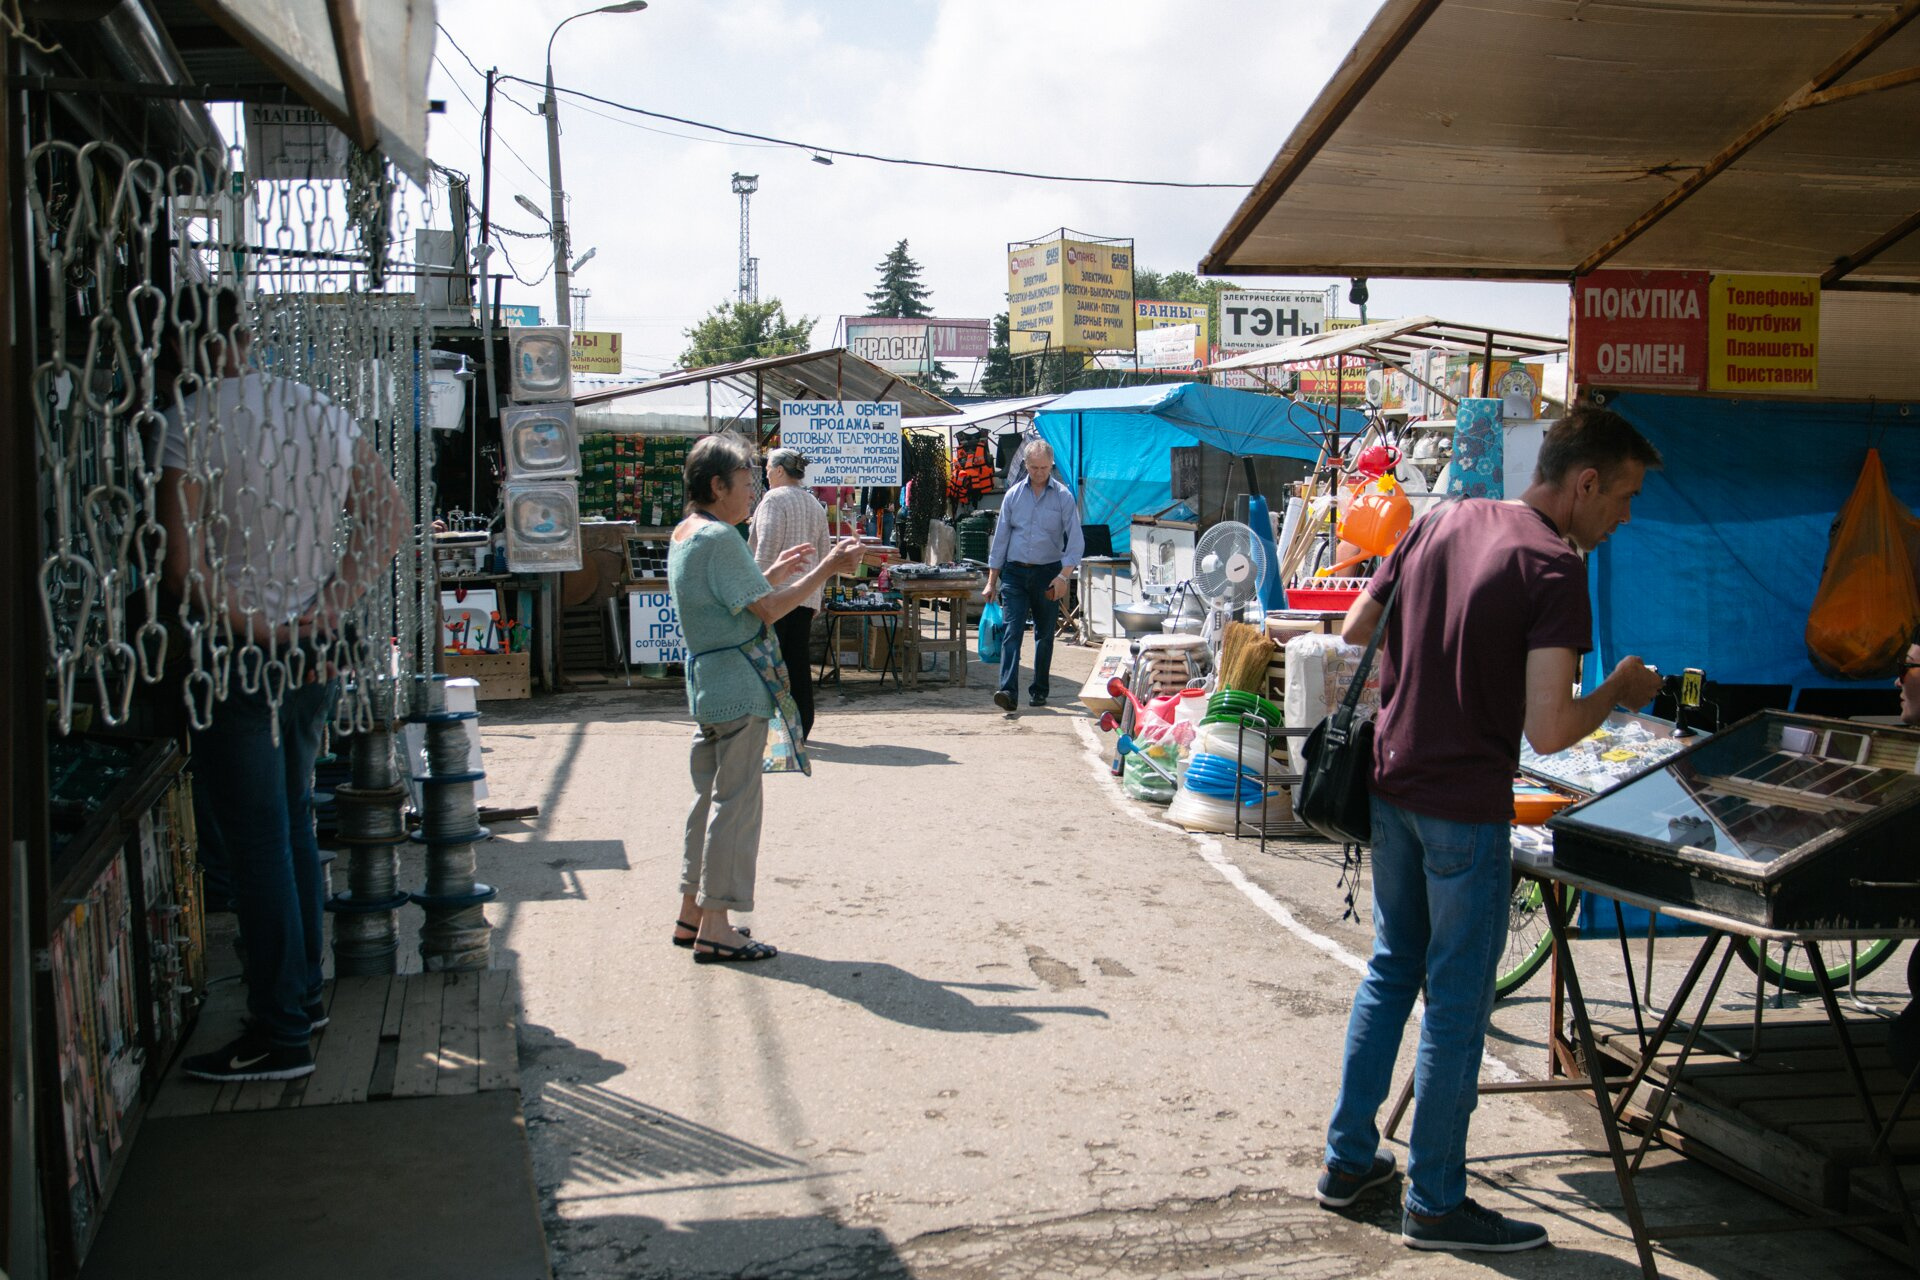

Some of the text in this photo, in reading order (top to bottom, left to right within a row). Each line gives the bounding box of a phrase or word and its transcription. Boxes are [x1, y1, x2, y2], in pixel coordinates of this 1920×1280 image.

[253, 109, 322, 122] МАГНИ
[1111, 253, 1129, 265] GUSI
[1081, 271, 1113, 285] ЭЛЕКТРИКА
[1223, 294, 1291, 302] ЭЛЕКТРИЧЕСКИЕ
[1584, 287, 1700, 320] ПОКУПКА
[1727, 287, 1814, 307] Телефоны
[1139, 304, 1192, 318] ВАННЫ
[1074, 314, 1123, 328] ДВЕРНЫЕ РУЧКИ
[1331, 323, 1362, 331] ОТКО
[1727, 313, 1801, 333] Ноутбуки
[1082, 330, 1107, 341] САМОРЕ
[854, 336, 928, 360] КРАСКА
[1727, 339, 1814, 358] Планшеты
[1596, 343, 1685, 374] ОБМЕН
[1727, 364, 1814, 384] Приставки
[782, 403, 899, 416] ПОКУПКА ОБМЕН
[810, 418, 871, 430] ПРОДАЖА
[783, 432, 899, 444] СОТОВЫХ ТЕЛЕФОНОВ
[784, 446, 899, 455] ЛОСИПЕДЫ МОПЕДЫ
[804, 456, 900, 464] БУКИ ФОТОАППАРАТЫ
[824, 466, 897, 474] АВТОМАГНИТОЛЫ
[813, 476, 897, 484] НАРДЫ ПРОЧЕЕ
[635, 639, 681, 648] СОТОВЫХ
